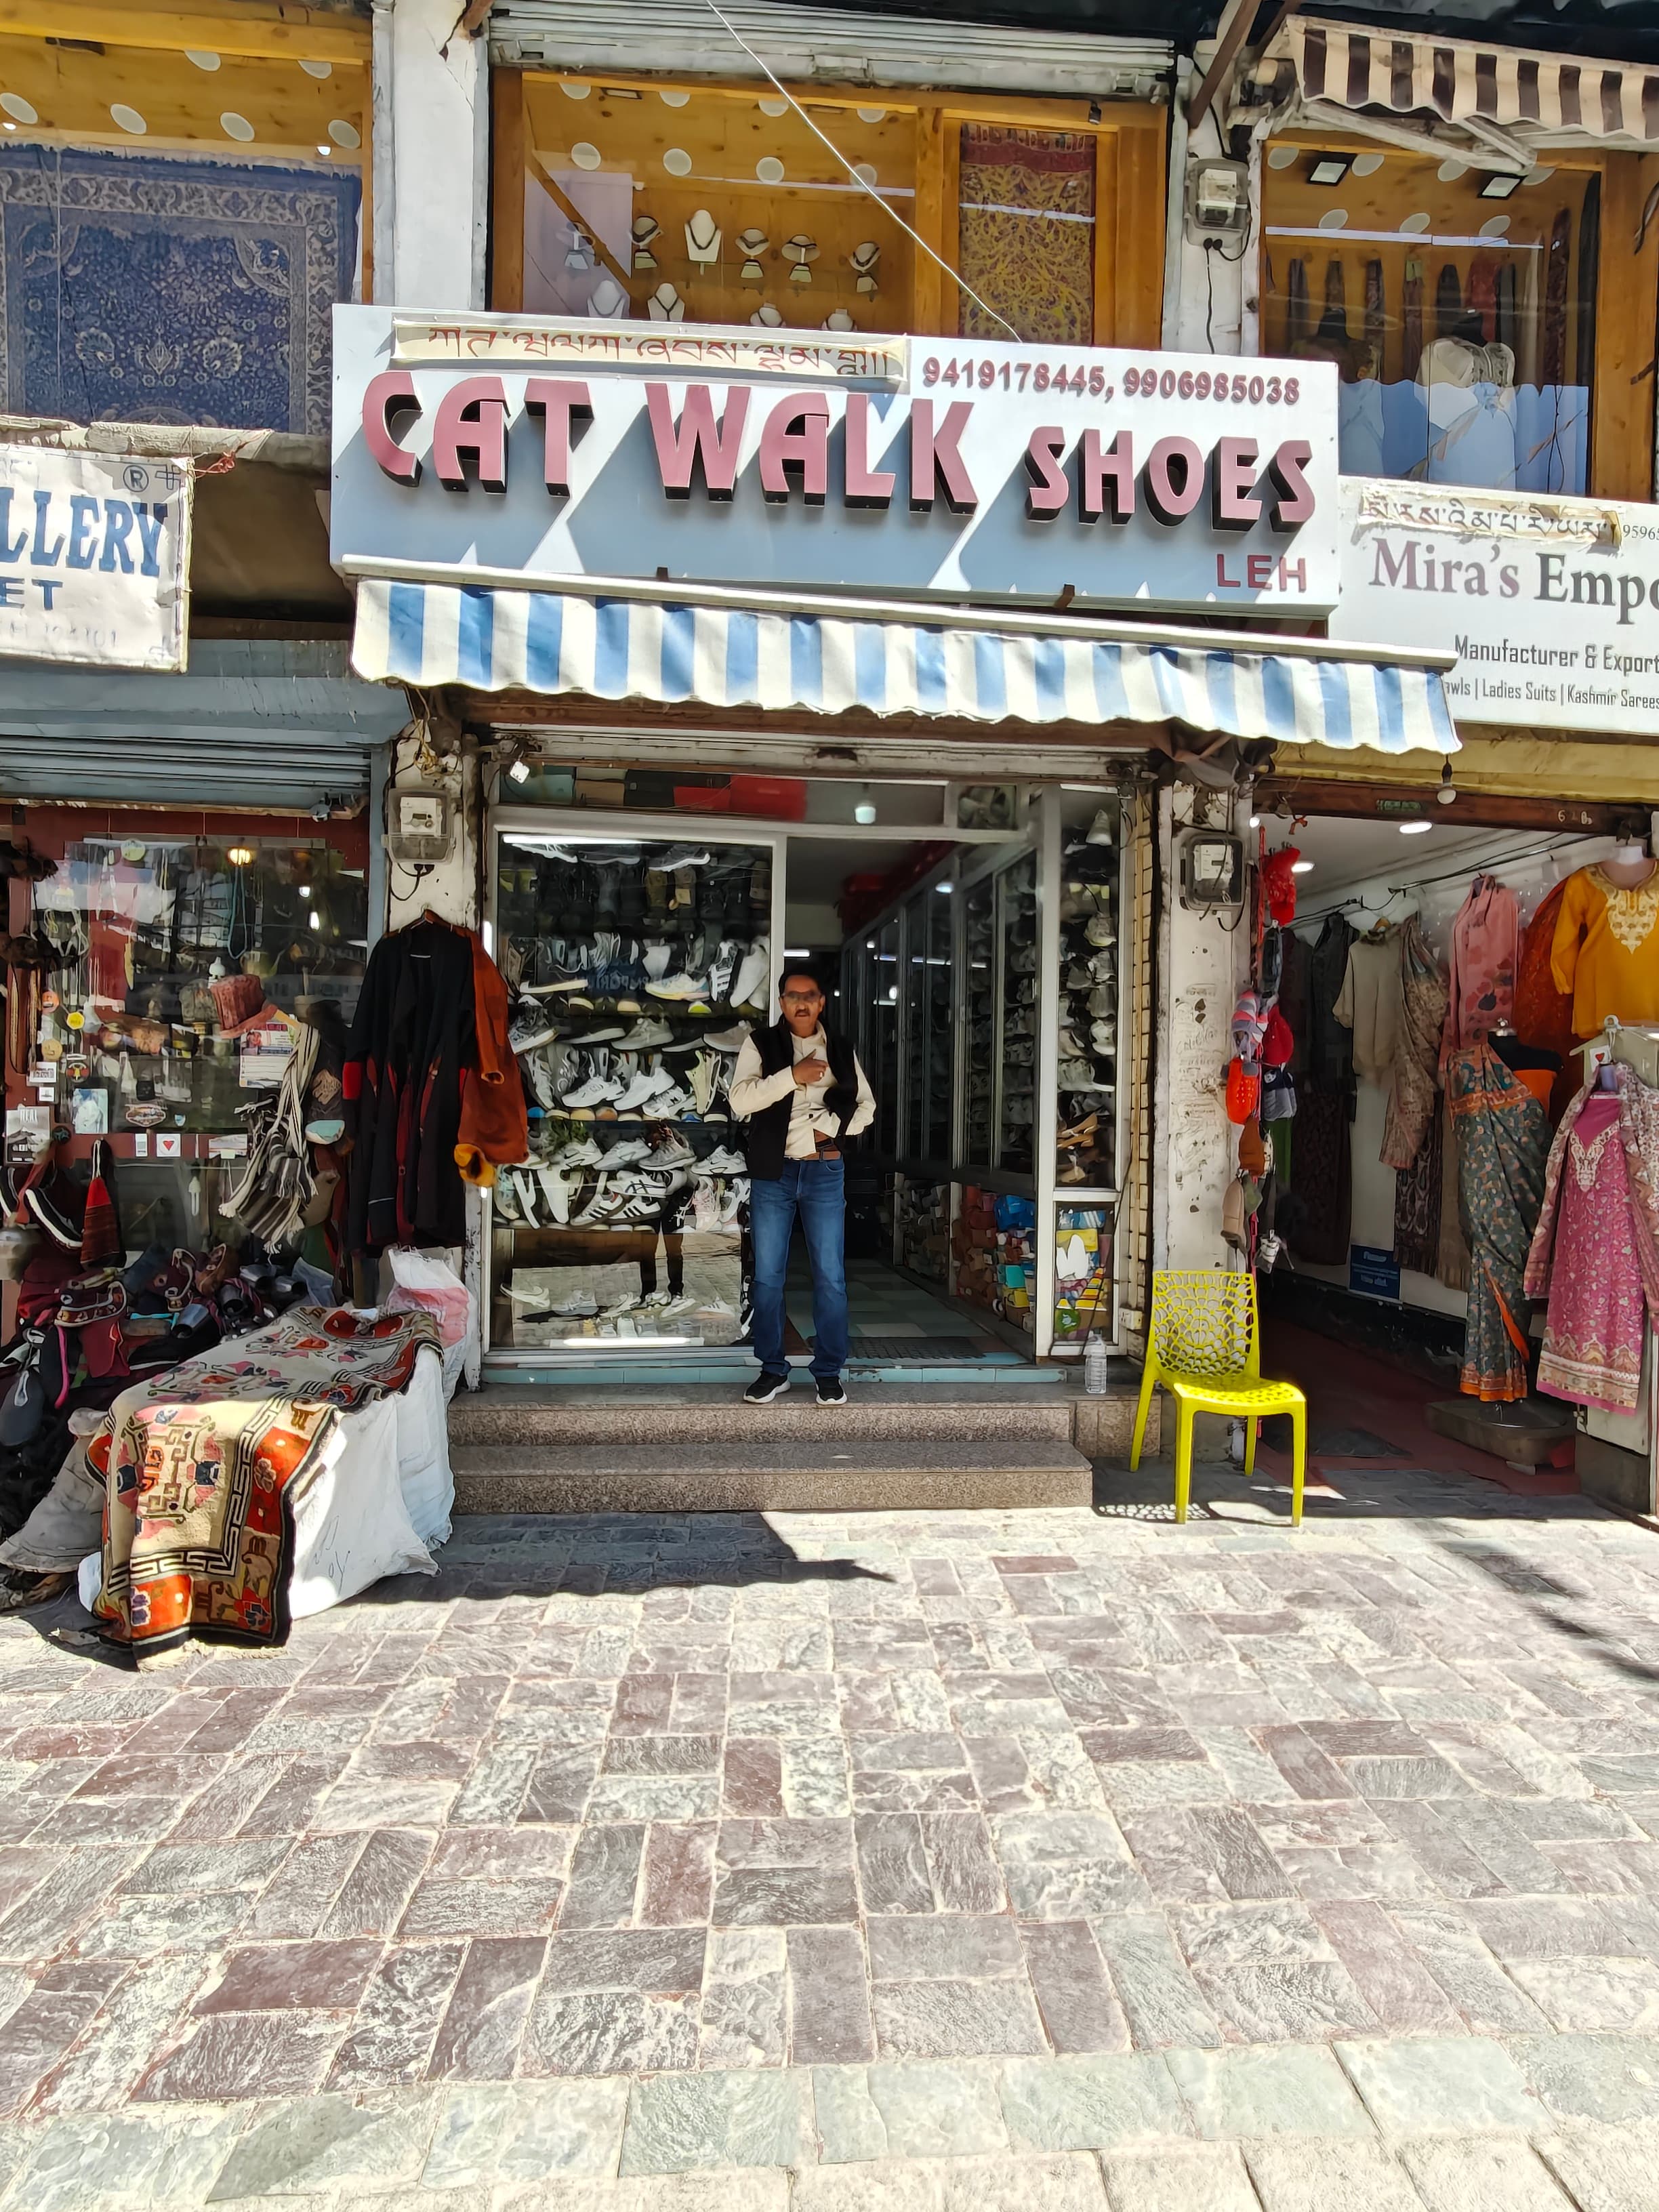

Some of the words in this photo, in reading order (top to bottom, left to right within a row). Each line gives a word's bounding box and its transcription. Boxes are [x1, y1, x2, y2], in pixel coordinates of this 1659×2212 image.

[923, 357, 1115, 401] 9419178445,
[1124, 367, 1300, 405] 9906985038
[363, 371, 594, 496] CAT
[644, 383, 977, 515] WALK
[1025, 426, 1315, 533] SHOES
[0, 487, 167, 577] LLERY
[1216, 553, 1307, 593] LEH
[1368, 537, 1520, 598] Mira's
[1454, 634, 1579, 667] Manufacturer
[1585, 642, 1597, 669] &
[1483, 678, 1521, 699] Ladies
[1526, 682, 1556, 702] Suits
[1568, 684, 1617, 706] Kashmir
